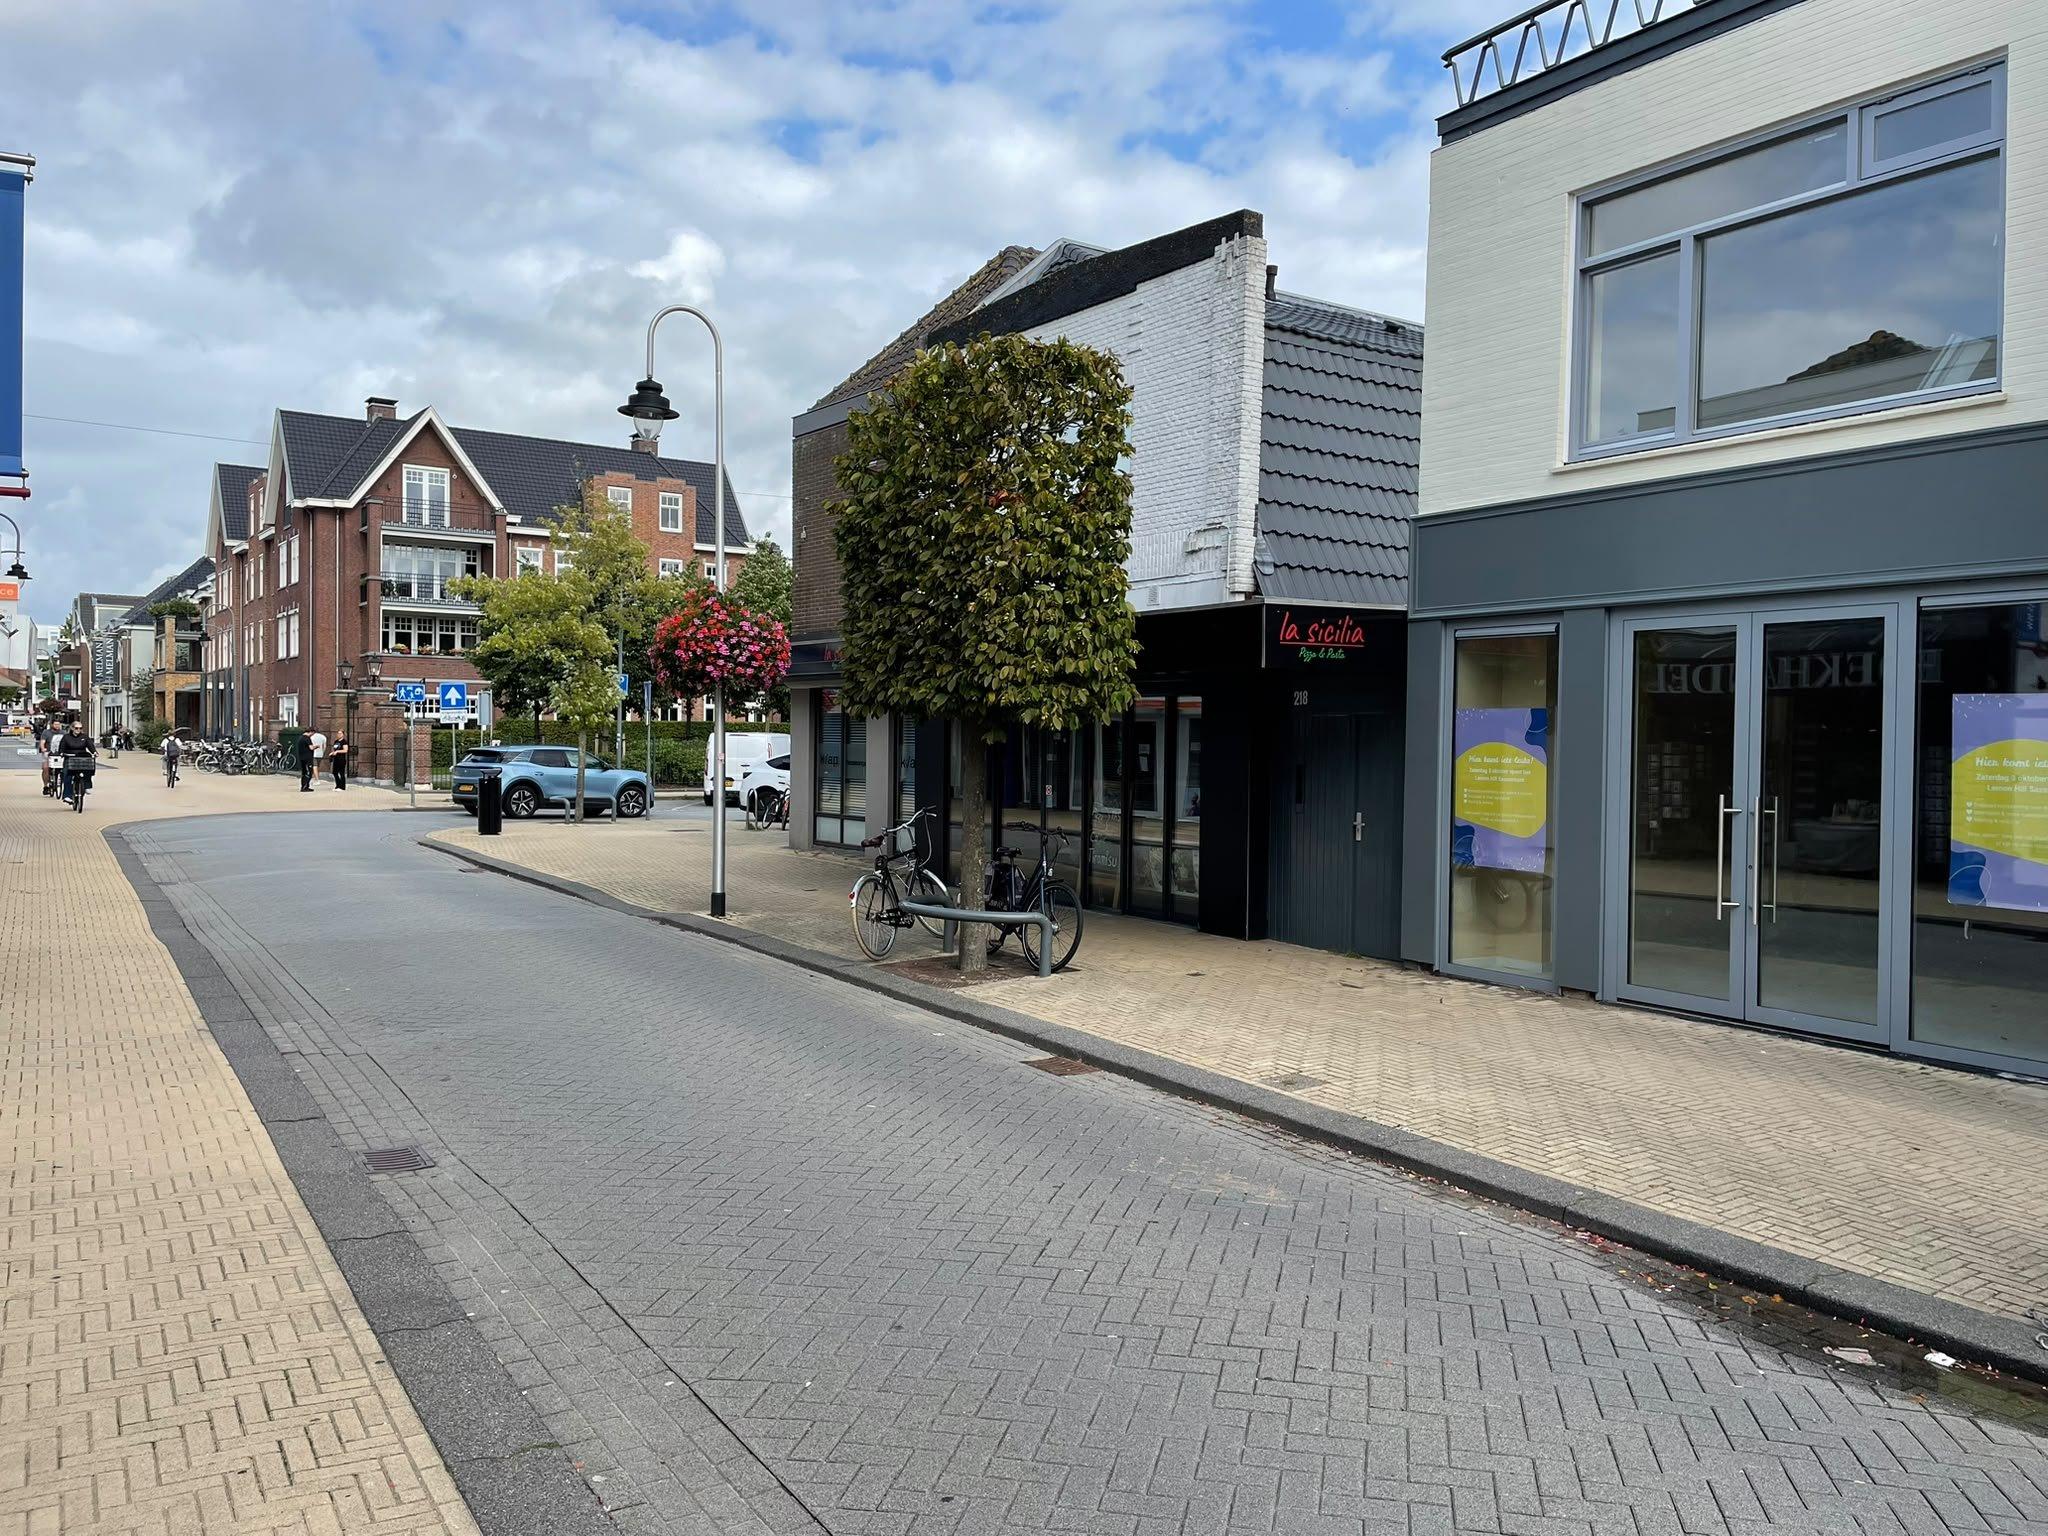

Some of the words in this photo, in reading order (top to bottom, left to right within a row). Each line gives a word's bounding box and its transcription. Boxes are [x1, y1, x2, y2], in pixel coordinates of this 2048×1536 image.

[1279, 611, 1300, 641] la
[1307, 614, 1365, 643] sicilia
[95, 642, 104, 677] MELMAN
[105, 638, 114, 675] MELMAN
[1298, 646, 1317, 663] Pizza
[1326, 648, 1346, 660] Pasta
[1293, 690, 1309, 706] 218
